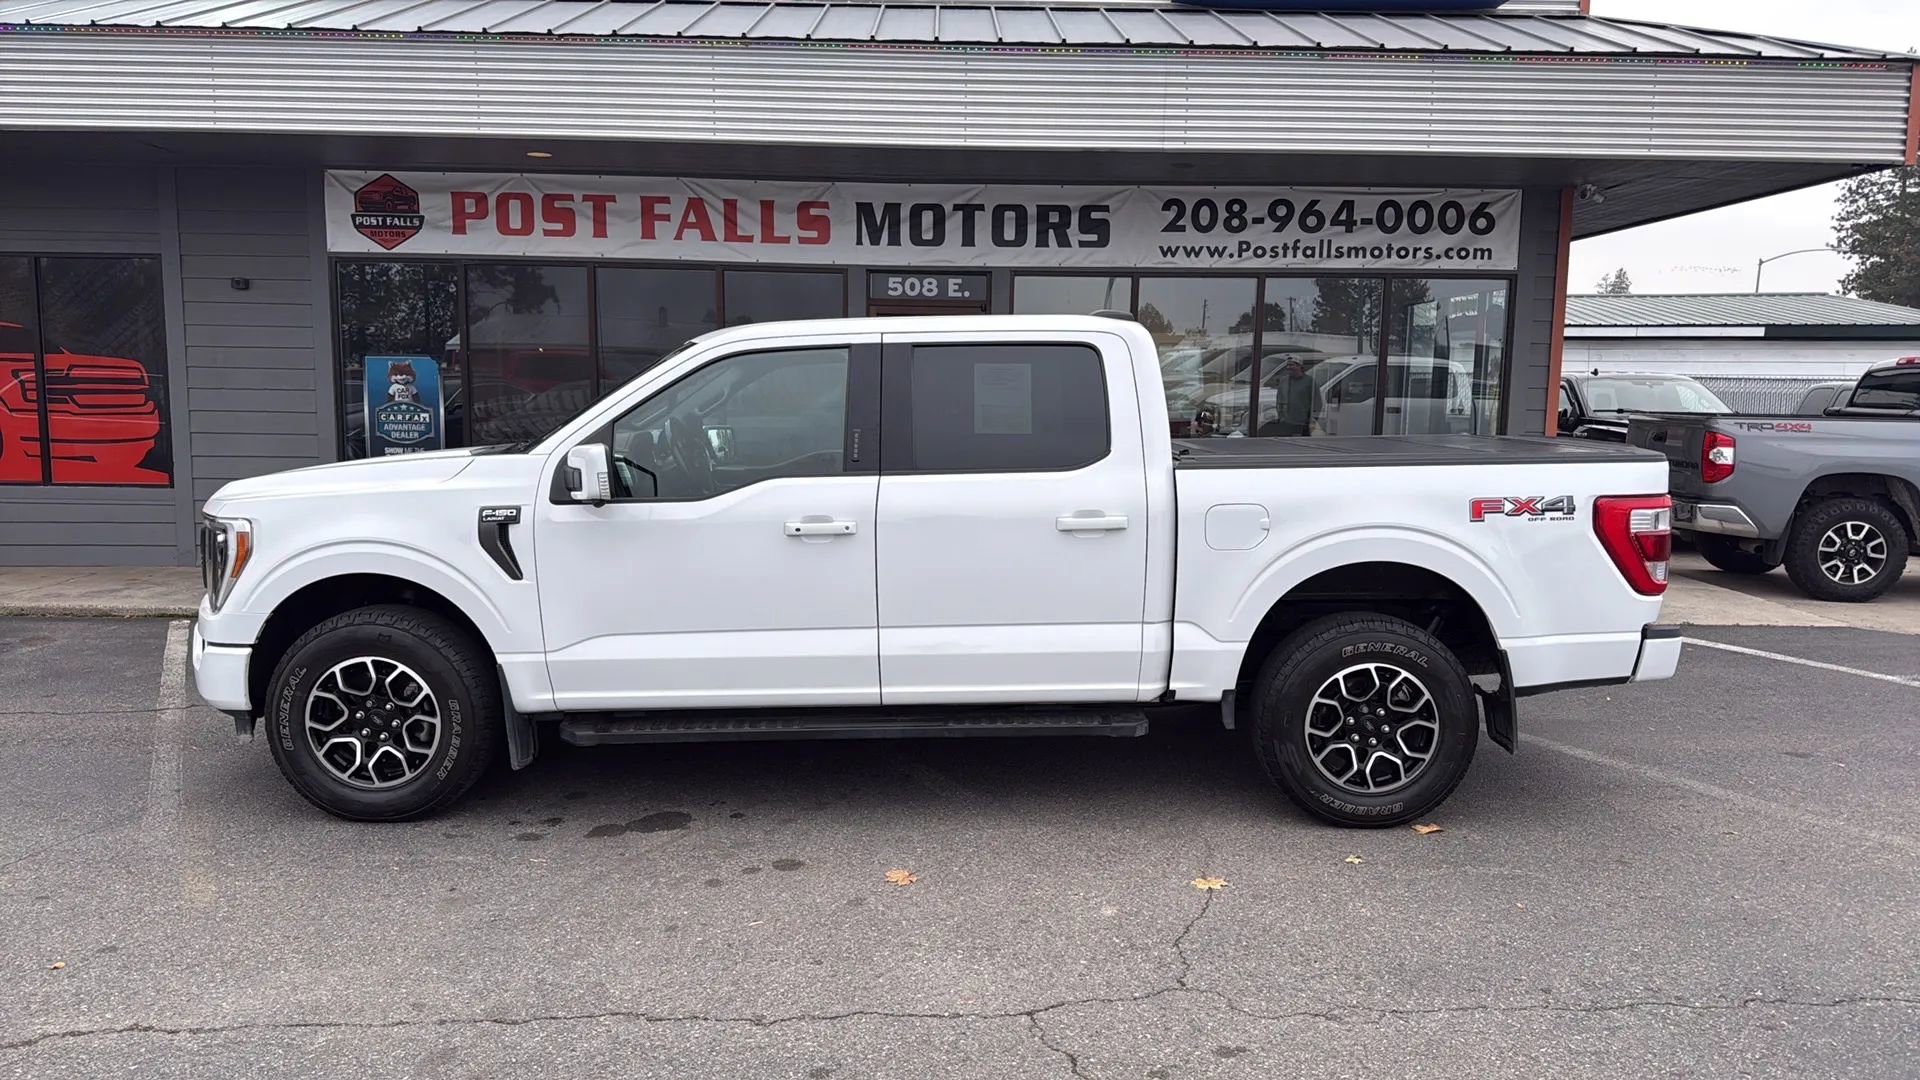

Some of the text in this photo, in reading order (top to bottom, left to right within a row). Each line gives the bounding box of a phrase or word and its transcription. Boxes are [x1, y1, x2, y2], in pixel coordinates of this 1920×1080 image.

[355, 216, 420, 227] POST FALLS
[449, 191, 1111, 249] POST FALLS MOTORS
[1159, 197, 1497, 236] 208-964-0006
[369, 230, 407, 238] MOTORS
[1158, 239, 1493, 261] www.Postfallsmotors.com
[887, 276, 970, 298] 508 E.
[380, 413, 430, 422] CARFAX
[383, 423, 427, 431] ADVANTAGE
[391, 431, 420, 439] DEALER
[482, 509, 517, 517] F-150
[1469, 495, 1576, 522] FX4
[1341, 641, 1429, 668] GENERAL
[278, 666, 308, 751] GENERAL
[436, 699, 463, 780] GRABBER
[1319, 792, 1404, 816] GRABBER
